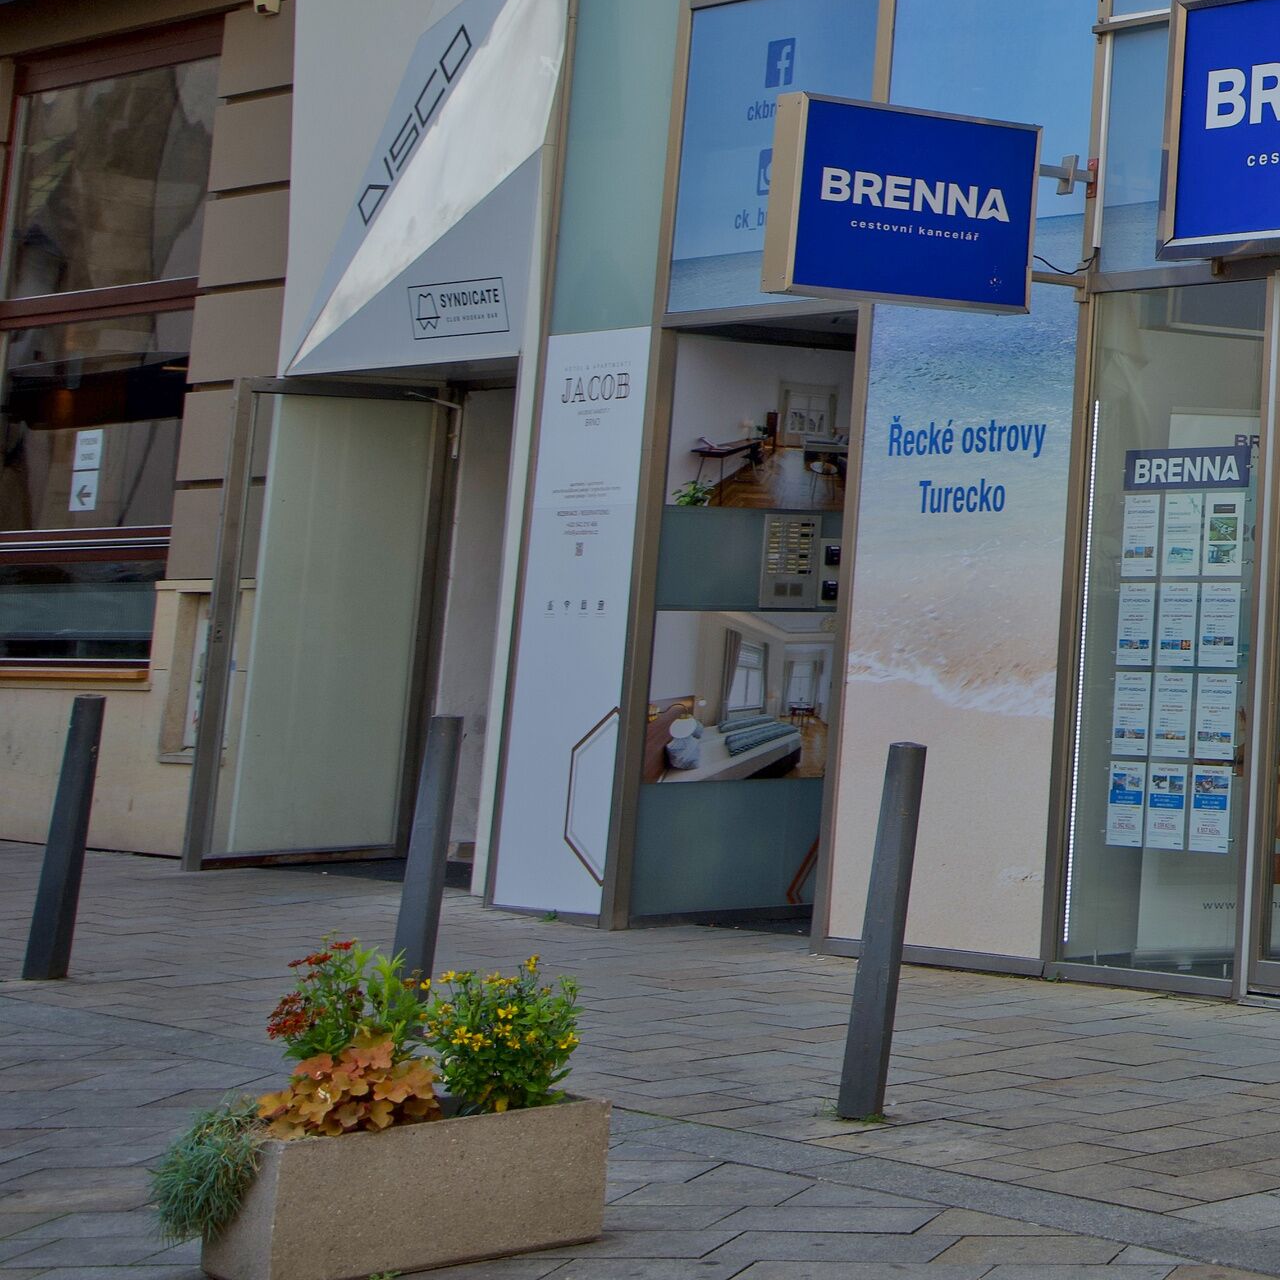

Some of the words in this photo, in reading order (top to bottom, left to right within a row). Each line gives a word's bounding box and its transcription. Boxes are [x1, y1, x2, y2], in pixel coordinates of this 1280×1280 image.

[820, 166, 1010, 223] BRENNA
[850, 219, 913, 234] cestovní
[918, 225, 980, 241] kancelář
[440, 289, 500, 308] SYNDICATE
[561, 373, 631, 403] JACOB
[888, 415, 954, 456] Řecké
[961, 419, 1046, 458] ostrovy
[1134, 455, 1240, 484] BRENNA
[919, 478, 1006, 513] Turecko
